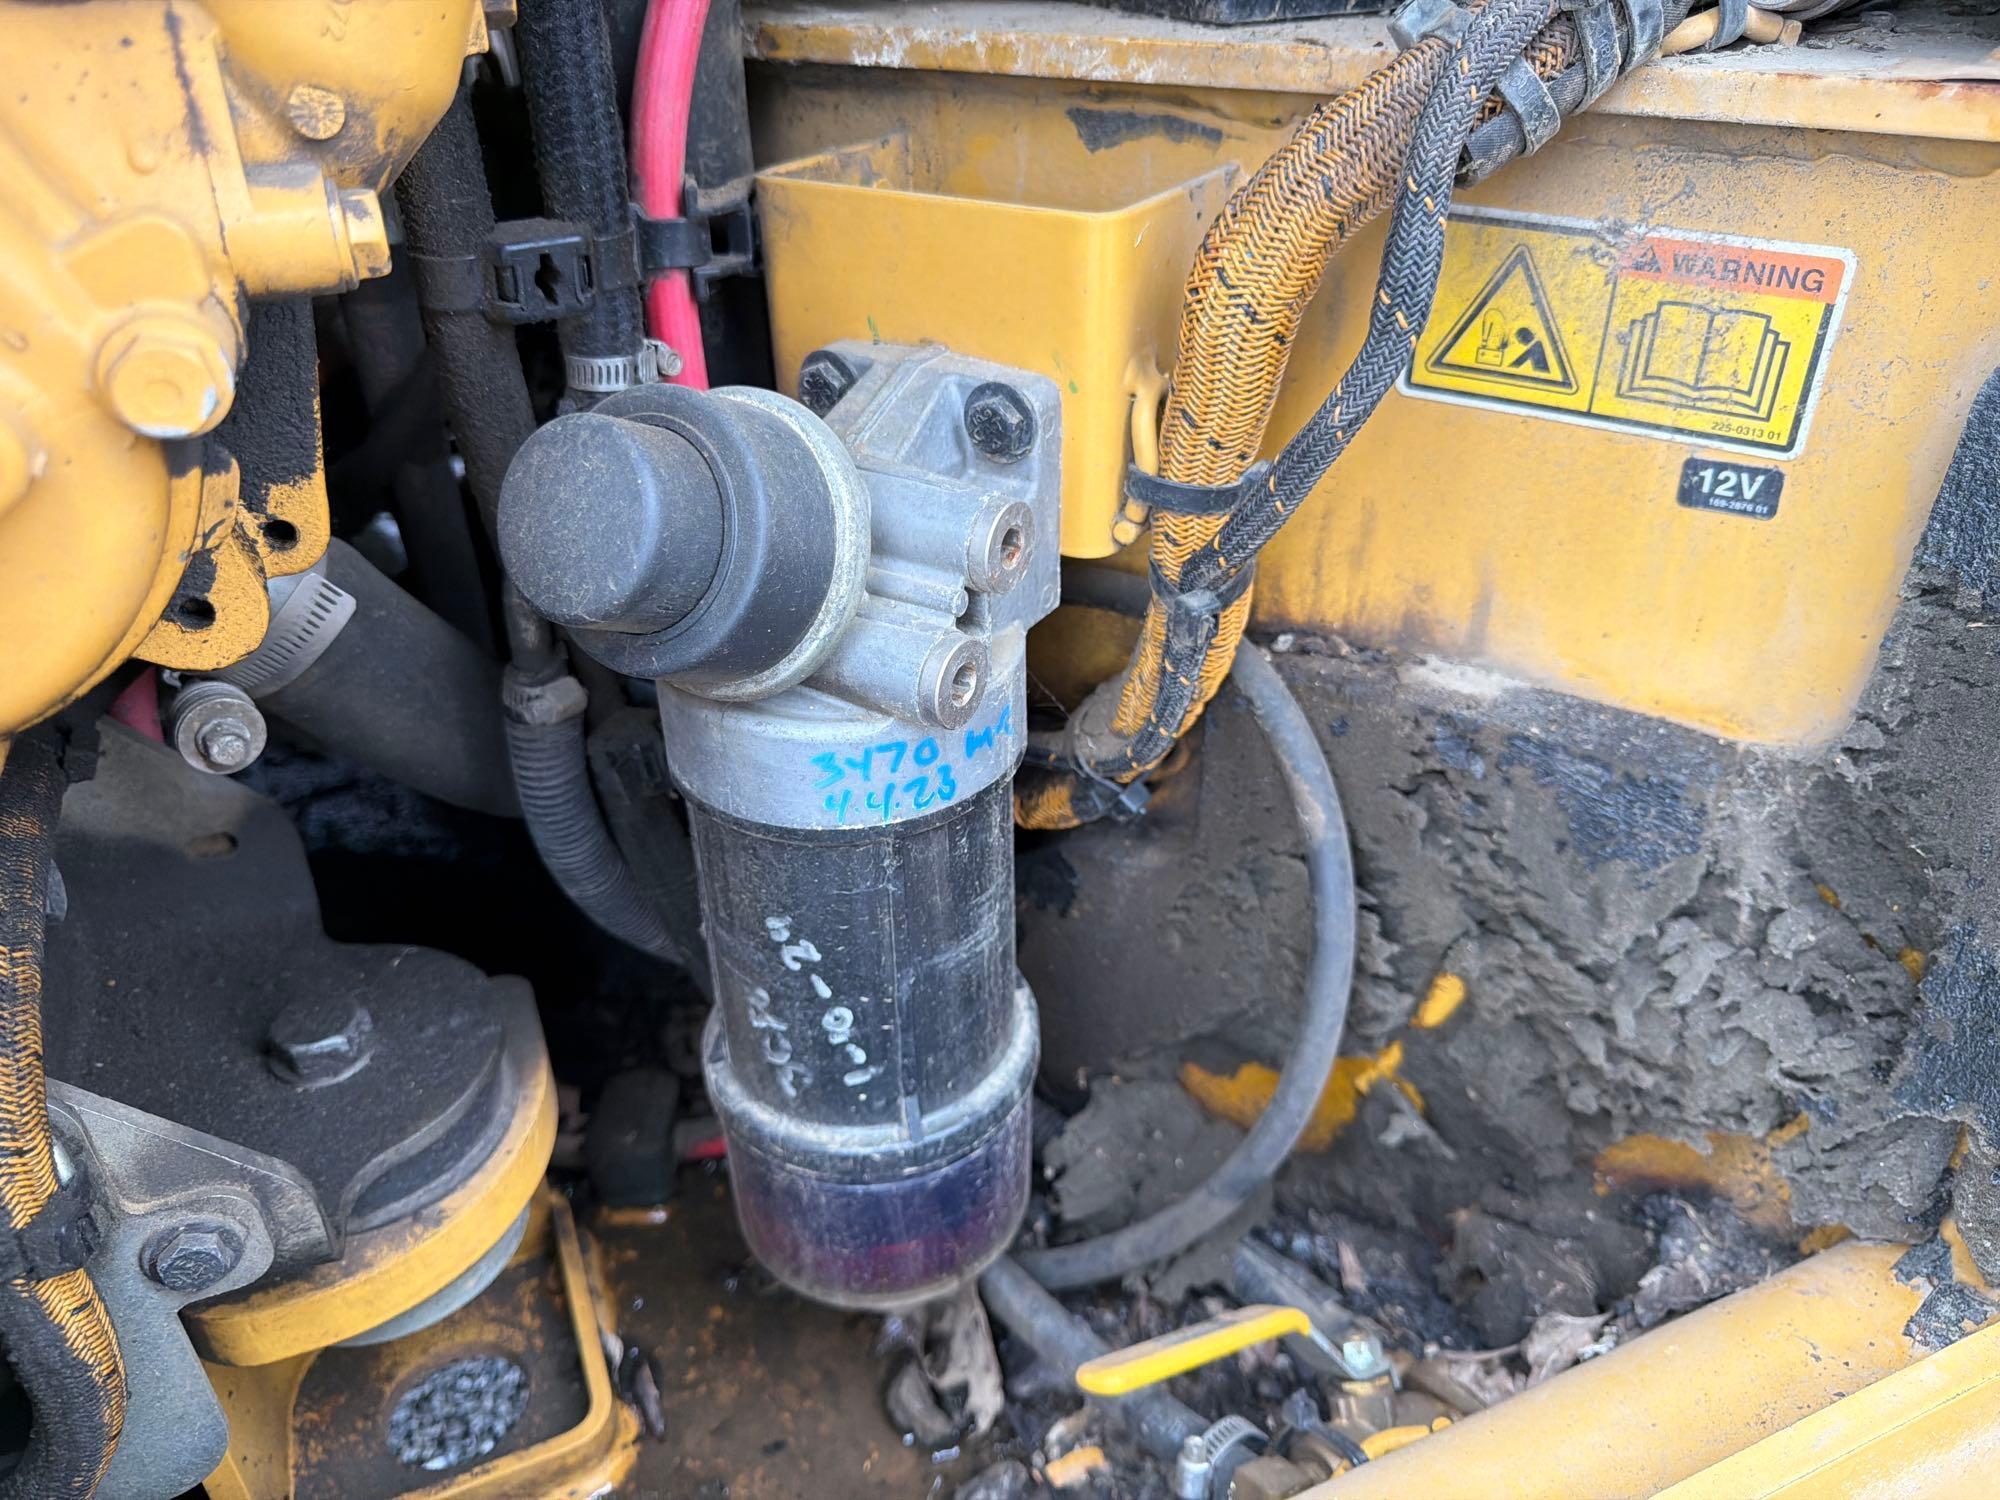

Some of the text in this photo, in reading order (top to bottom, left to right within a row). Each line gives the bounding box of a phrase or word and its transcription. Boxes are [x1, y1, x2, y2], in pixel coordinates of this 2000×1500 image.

[1672, 251, 1825, 294] WARNING
[1711, 421, 1781, 441] 225-0313 01
[1698, 467, 1766, 500] 12V
